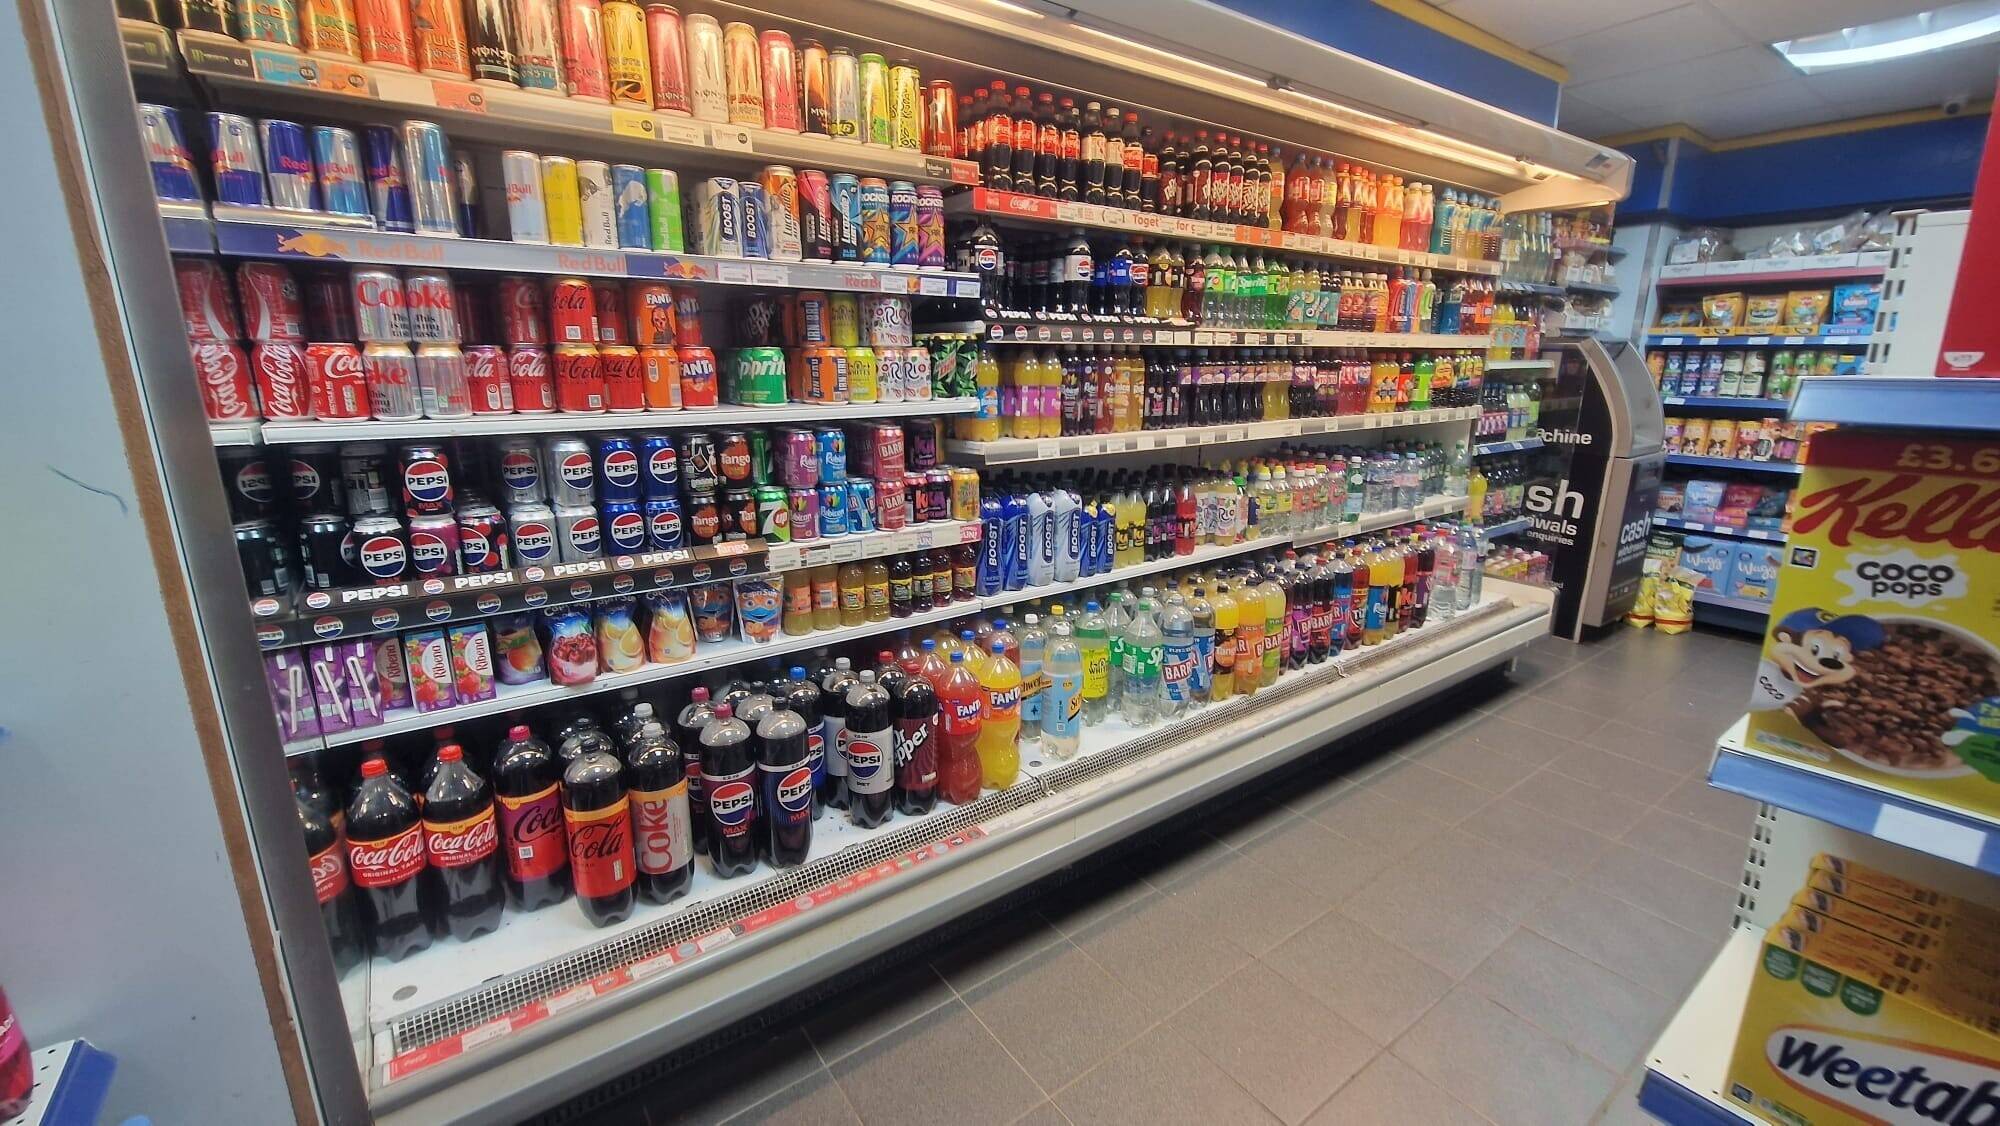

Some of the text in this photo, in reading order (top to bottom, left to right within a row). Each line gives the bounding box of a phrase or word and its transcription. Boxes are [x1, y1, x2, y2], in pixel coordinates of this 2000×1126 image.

[472, 46, 515, 61] MONST
[862, 192, 890, 203] OCKSTA
[891, 194, 918, 206] ROCKS
[919, 198, 944, 208] OCKST
[720, 196, 734, 236] BOOST
[746, 201, 758, 239] BOOST
[1132, 213, 1160, 228] Toget
[357, 239, 444, 263] Red Bull
[558, 252, 625, 273] Red Bull
[510, 352, 546, 379] Cola
[680, 360, 714, 377] FANTA
[752, 356, 786, 379] prite
[720, 453, 750, 467] Tango
[504, 465, 538, 475] PEPSI
[606, 464, 638, 474] PEPSI
[292, 475, 317, 485] PSI
[408, 475, 448, 486] PEPSI
[1525, 478, 1585, 519] sh
[691, 515, 719, 527] Tango
[739, 510, 756, 521] Tan
[820, 505, 846, 520] Rubicon
[614, 525, 643, 536] PEPSI
[654, 522, 681, 532] PEPSI
[1070, 514, 1081, 554] BOOST
[1620, 511, 1651, 545] cash
[516, 536, 551, 547] PEPSI
[988, 523, 998, 567] BOOST
[1018, 517, 1028, 561] BOOST
[1045, 517, 1054, 558] BOOST
[1090, 524, 1098, 559] BOOST
[1107, 521, 1116, 556] BOOST
[1526, 530, 1574, 546] enquiries
[415, 547, 446, 557] EPSI
[463, 541, 487, 552] EPSI
[714, 543, 749, 555] Tango
[364, 551, 406, 563] PEPSI
[641, 549, 690, 565] PEPSI
[1686, 552, 1724, 572] Wagg
[553, 560, 607, 577] PEPSI
[1737, 559, 1778, 580] Wagg
[1856, 561, 1955, 583] COCO
[454, 572, 513, 589] PEPSI
[342, 584, 409, 603] PEPSI
[1871, 579, 1944, 600] pops
[373, 615, 398, 623] PEPSI
[427, 607, 450, 615] PEPSI
[316, 623, 343, 632] PEPSI
[475, 637, 489, 672] Ribena
[1215, 646, 1235, 656] Tang
[434, 645, 448, 680] Ribena
[1165, 663, 1192, 681] BARR
[990, 685, 1021, 705] FANTA
[849, 754, 881, 765] PEPSI
[713, 793, 753, 810] PEPSI
[429, 820, 498, 854] Coca-Cola
[641, 799, 674, 875] Coke
[723, 825, 748, 836] MAX
[350, 831, 426, 871] Coca-Cola
